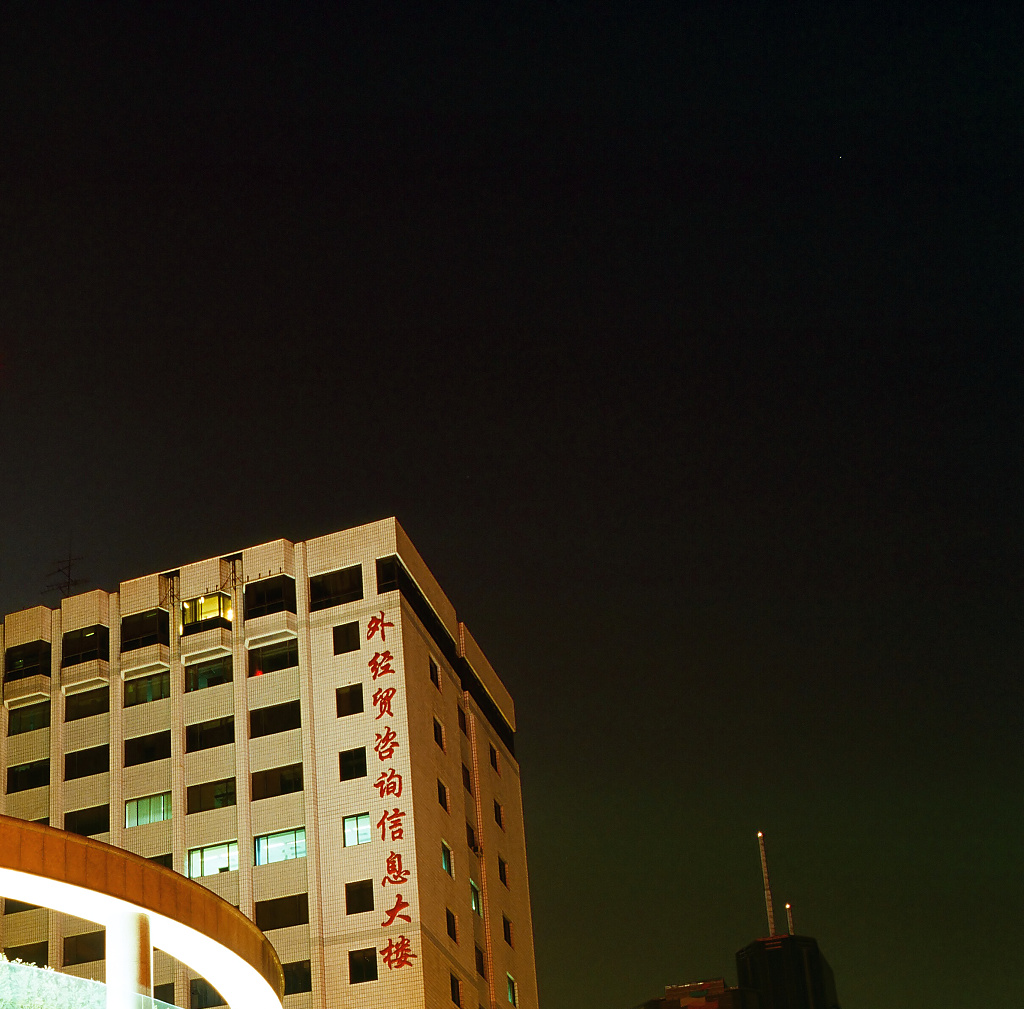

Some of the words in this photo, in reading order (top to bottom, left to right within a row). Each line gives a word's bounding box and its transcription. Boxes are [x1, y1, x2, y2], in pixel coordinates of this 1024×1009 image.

[366, 611, 418, 970] 外经贸咨询信息大楼
